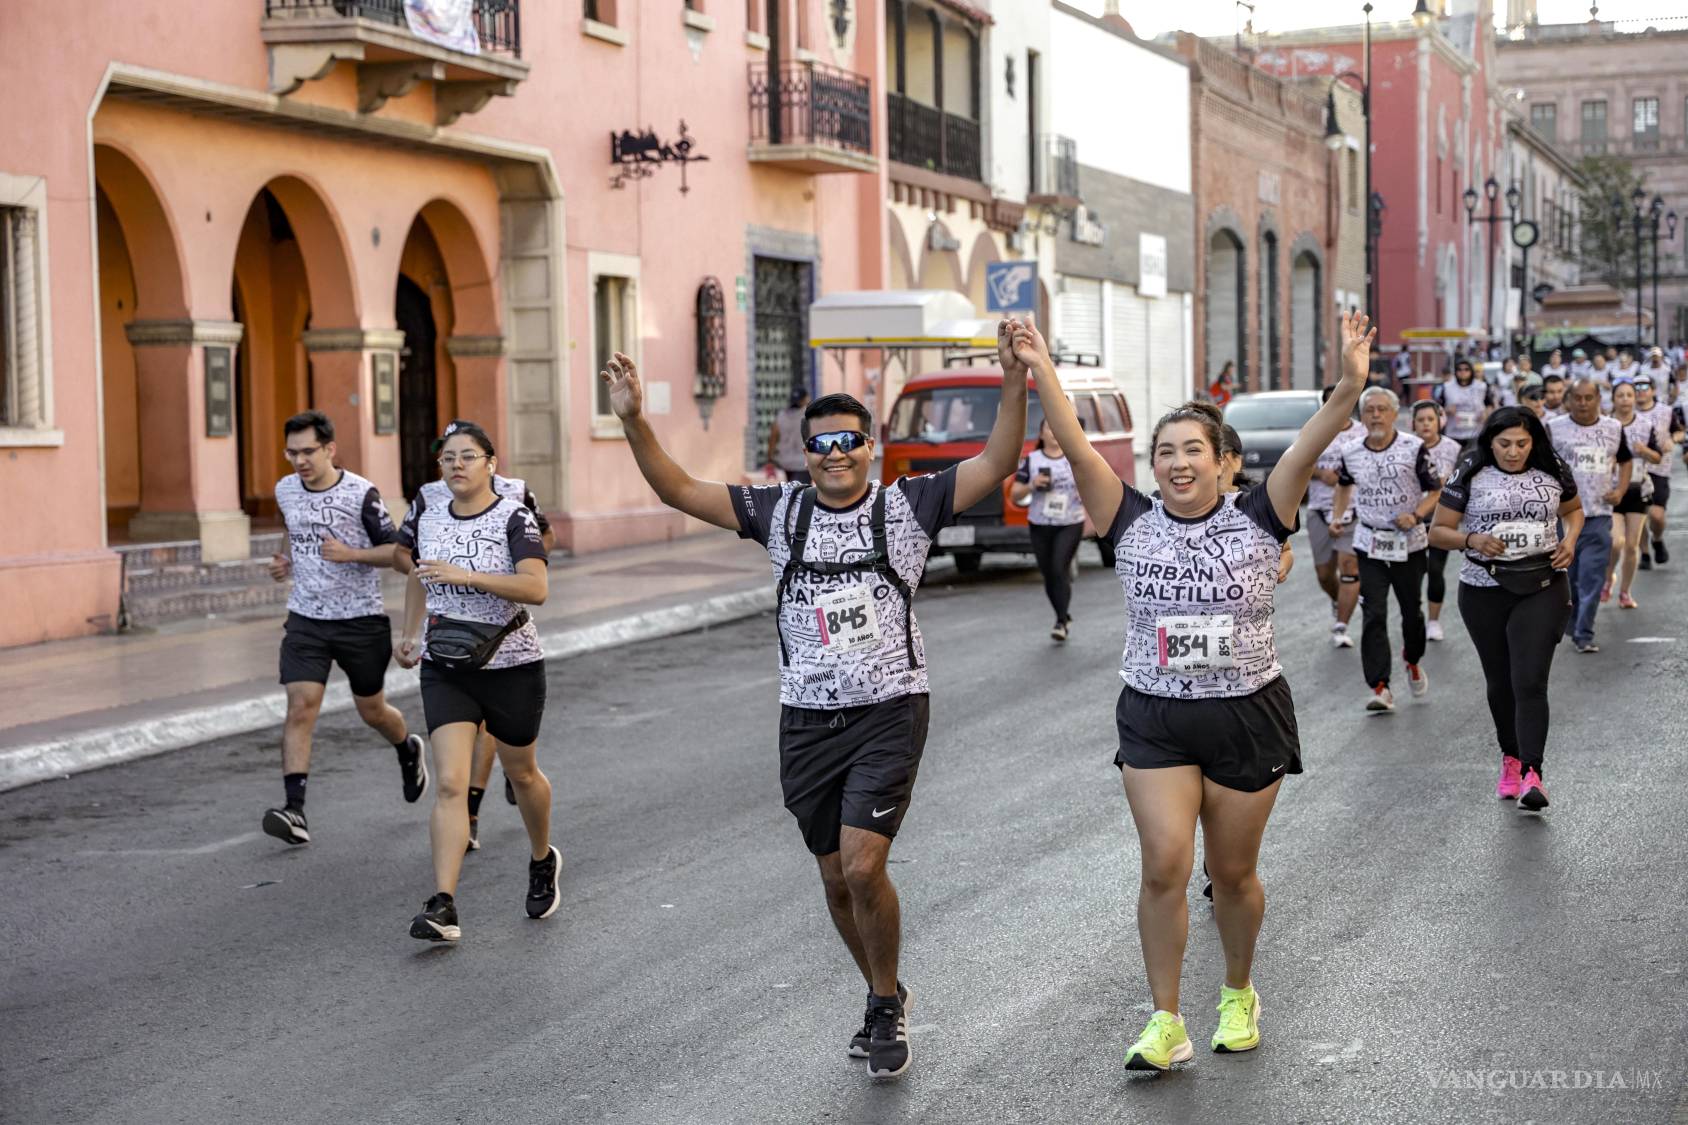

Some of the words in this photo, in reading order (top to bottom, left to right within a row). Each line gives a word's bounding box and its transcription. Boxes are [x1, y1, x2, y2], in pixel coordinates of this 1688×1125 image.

[1481, 510, 1538, 522] URBAN
[1136, 561, 1214, 583] URBAN
[1134, 581, 1244, 602] SALTILLO
[826, 604, 868, 635] 845
[1167, 635, 1208, 658] 854
[1218, 636, 1230, 657] 854
[803, 669, 836, 685] RUNNING
